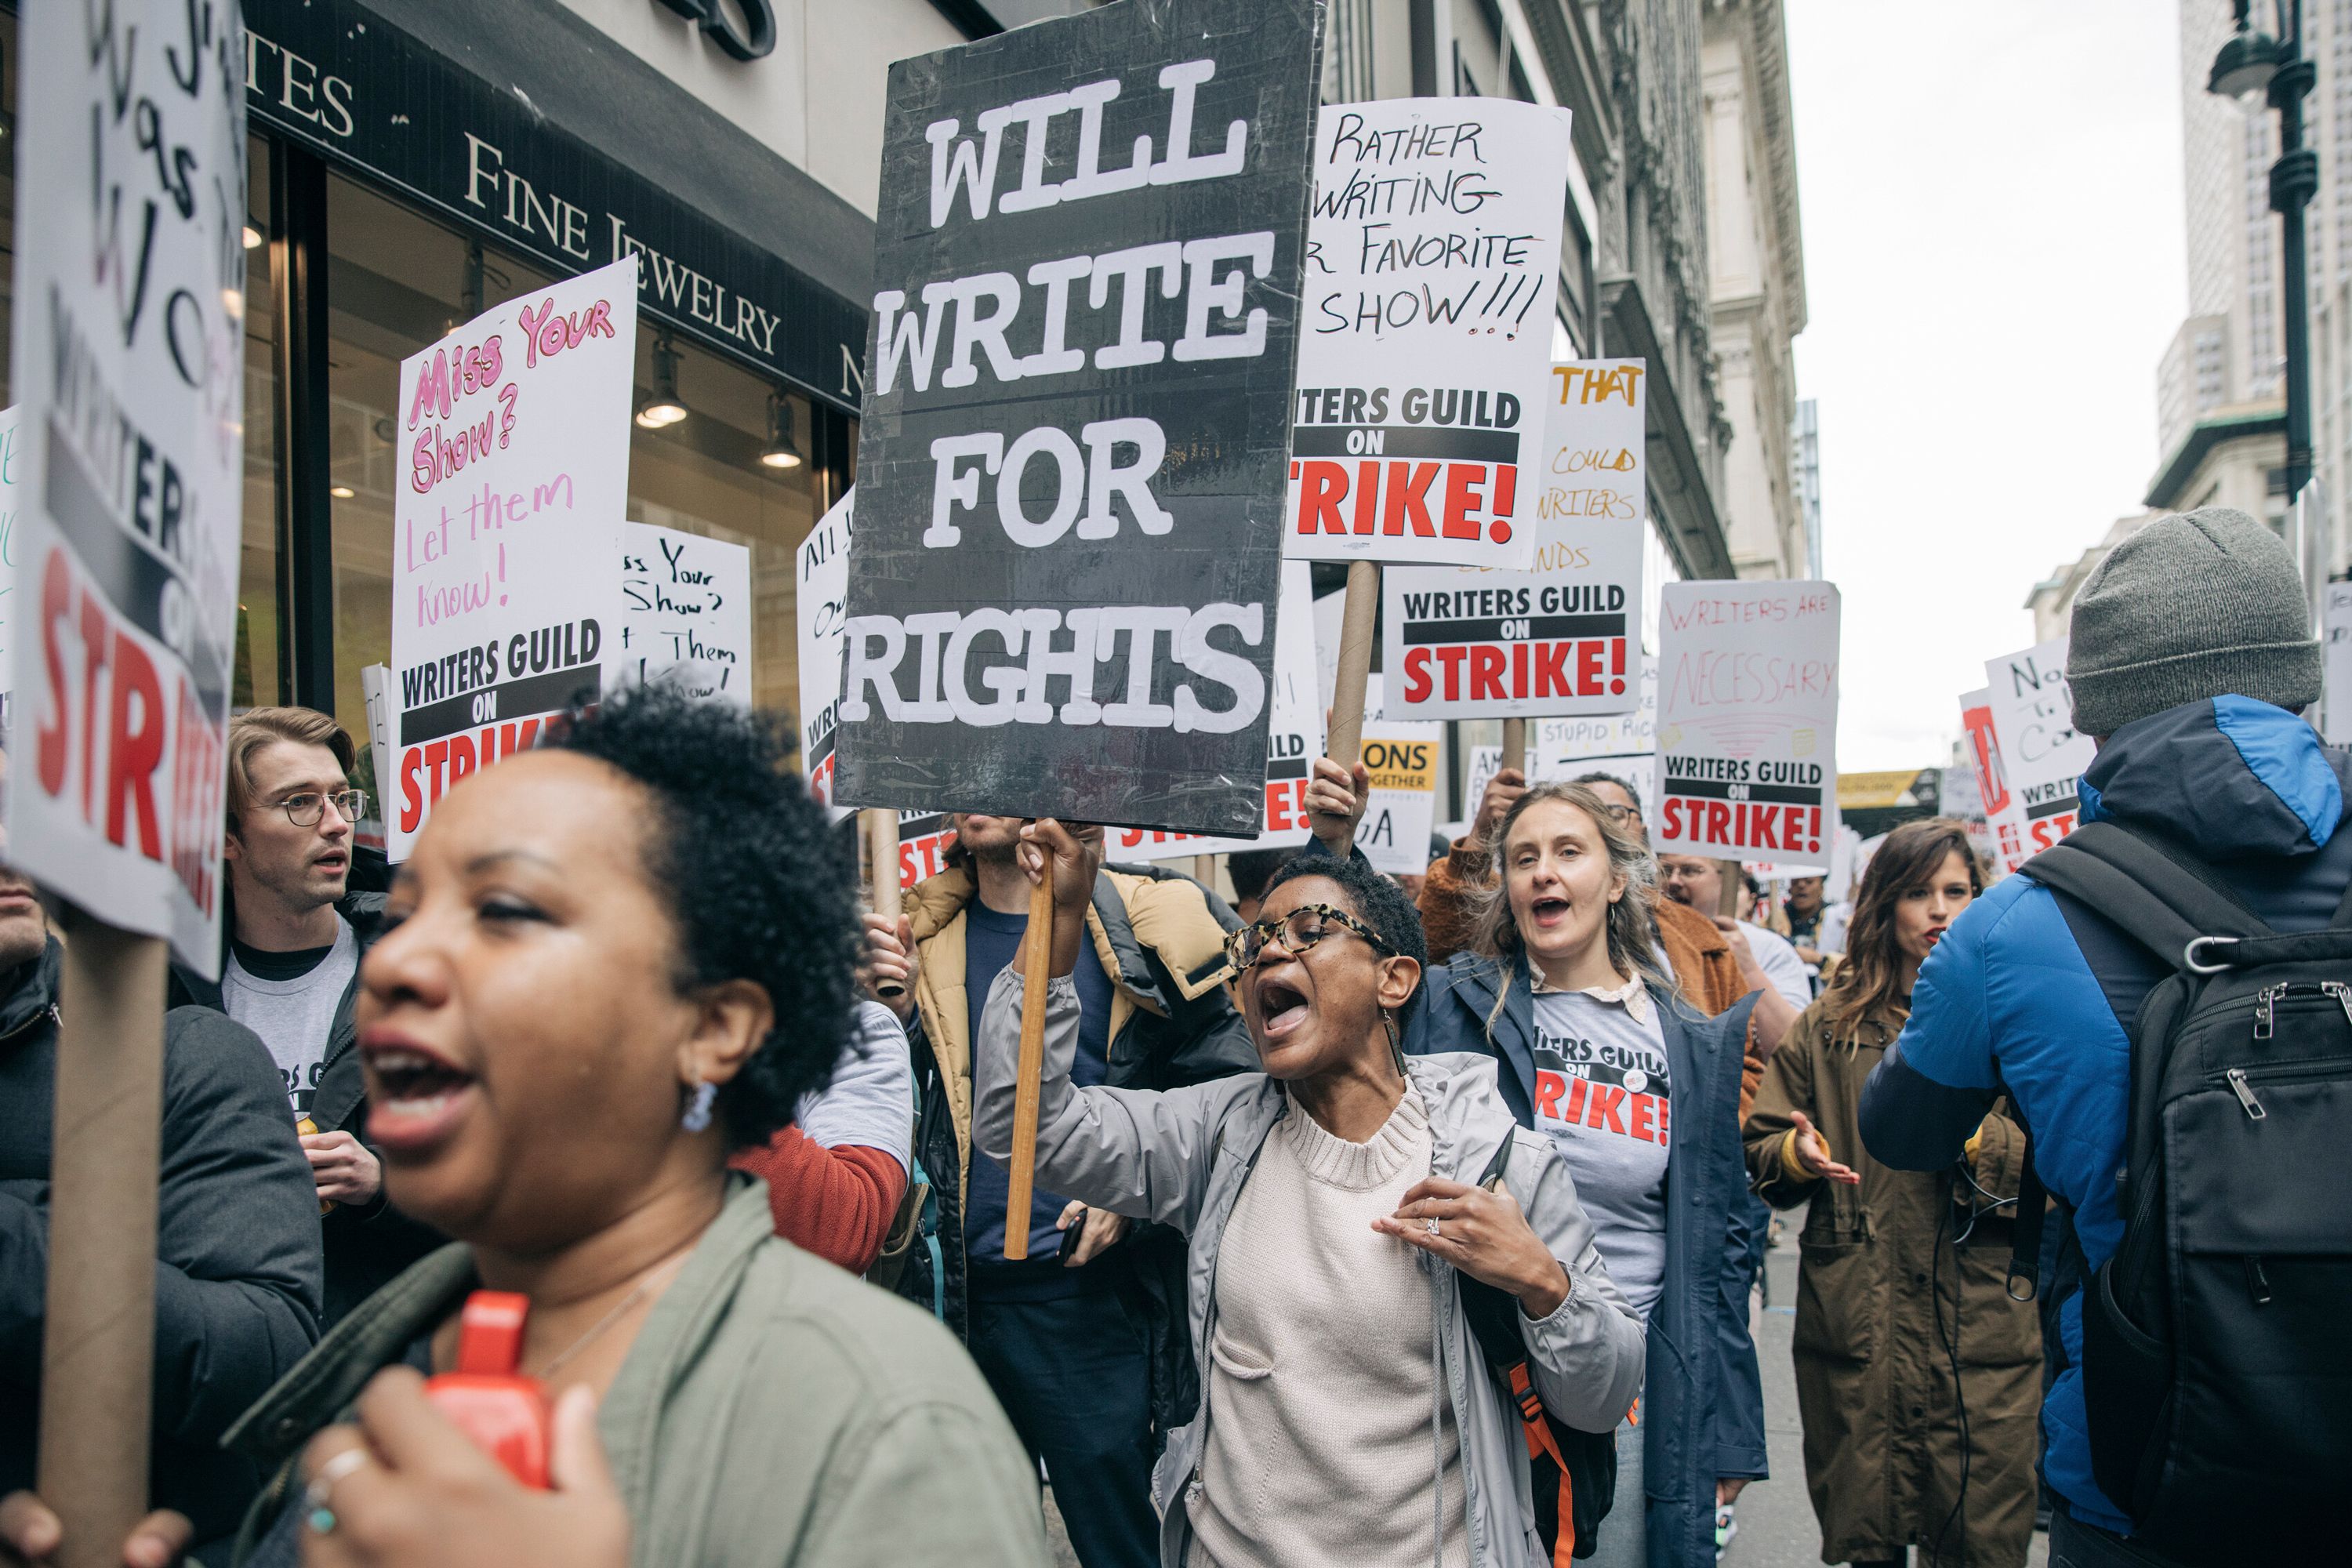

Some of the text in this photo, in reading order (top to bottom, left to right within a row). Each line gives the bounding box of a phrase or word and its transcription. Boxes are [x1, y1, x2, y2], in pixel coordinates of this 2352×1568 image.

[925, 59, 1247, 228] WILL
[1330, 114, 1486, 165] RATHER
[1313, 168, 1503, 220] WRITING
[1363, 223, 1544, 274] FAVORITE
[873, 231, 1275, 396] WRITE
[1316, 273, 1544, 341] SHOW!!!
[1402, 388, 1520, 428] GUILD
[1553, 365, 1643, 407] THAT
[1346, 430, 1385, 455] ON
[1552, 446, 1635, 474] COULD
[923, 417, 1174, 548] FOR
[407, 474, 573, 573] Let them
[659, 538, 715, 585] Your
[1403, 585, 1625, 619] WRITERS GUILD
[1665, 595, 1828, 631] WRITERS ARE
[660, 628, 736, 663] Them
[1501, 619, 1530, 640] ON
[401, 618, 601, 709] WRITERS GUILD
[839, 602, 1265, 734] RIGHTS
[1404, 638, 1625, 703] STRIKE!
[1668, 651, 1838, 713] NECESSARY
[472, 690, 497, 724] ON
[1544, 722, 1608, 743] STUPID
[1666, 757, 1749, 781] WRITERS
[1758, 761, 1822, 785] GUILD
[1727, 784, 1750, 800] ON
[1662, 797, 1821, 853] STRIKE!
[1565, 1063, 1591, 1080] ON
[1599, 1045, 1668, 1080] GUILD
